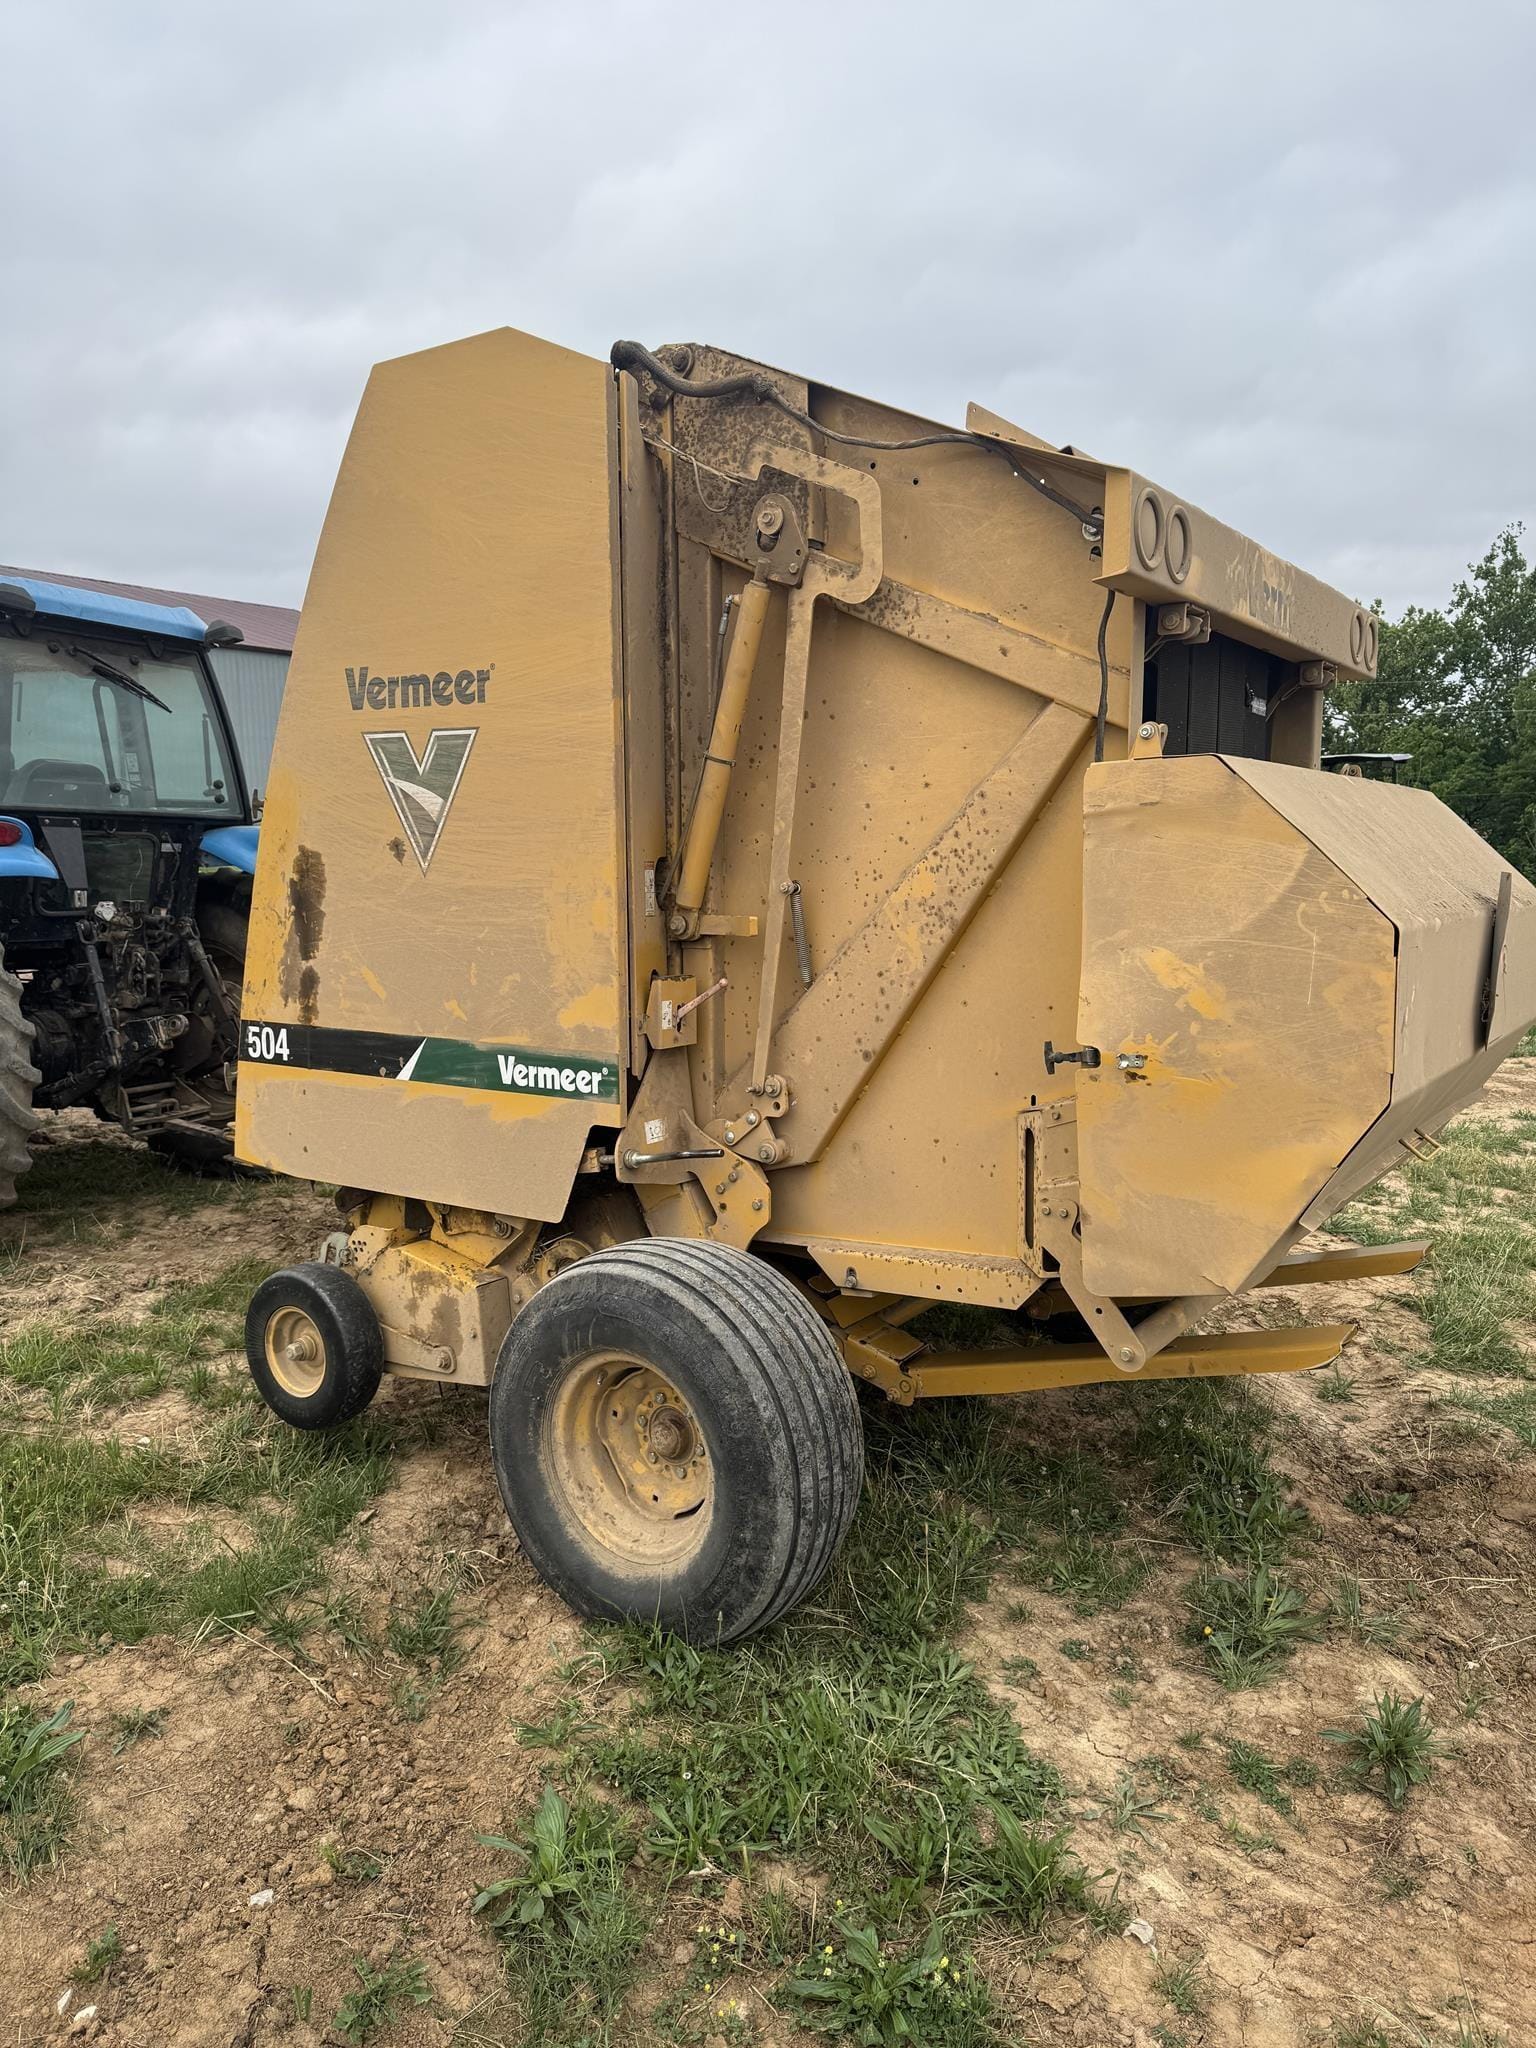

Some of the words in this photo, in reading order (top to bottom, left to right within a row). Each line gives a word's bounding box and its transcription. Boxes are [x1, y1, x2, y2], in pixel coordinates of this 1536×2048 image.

[345, 665, 492, 710] Vermeer
[247, 1025, 290, 1061] 504
[497, 1055, 604, 1095] Vermeer
